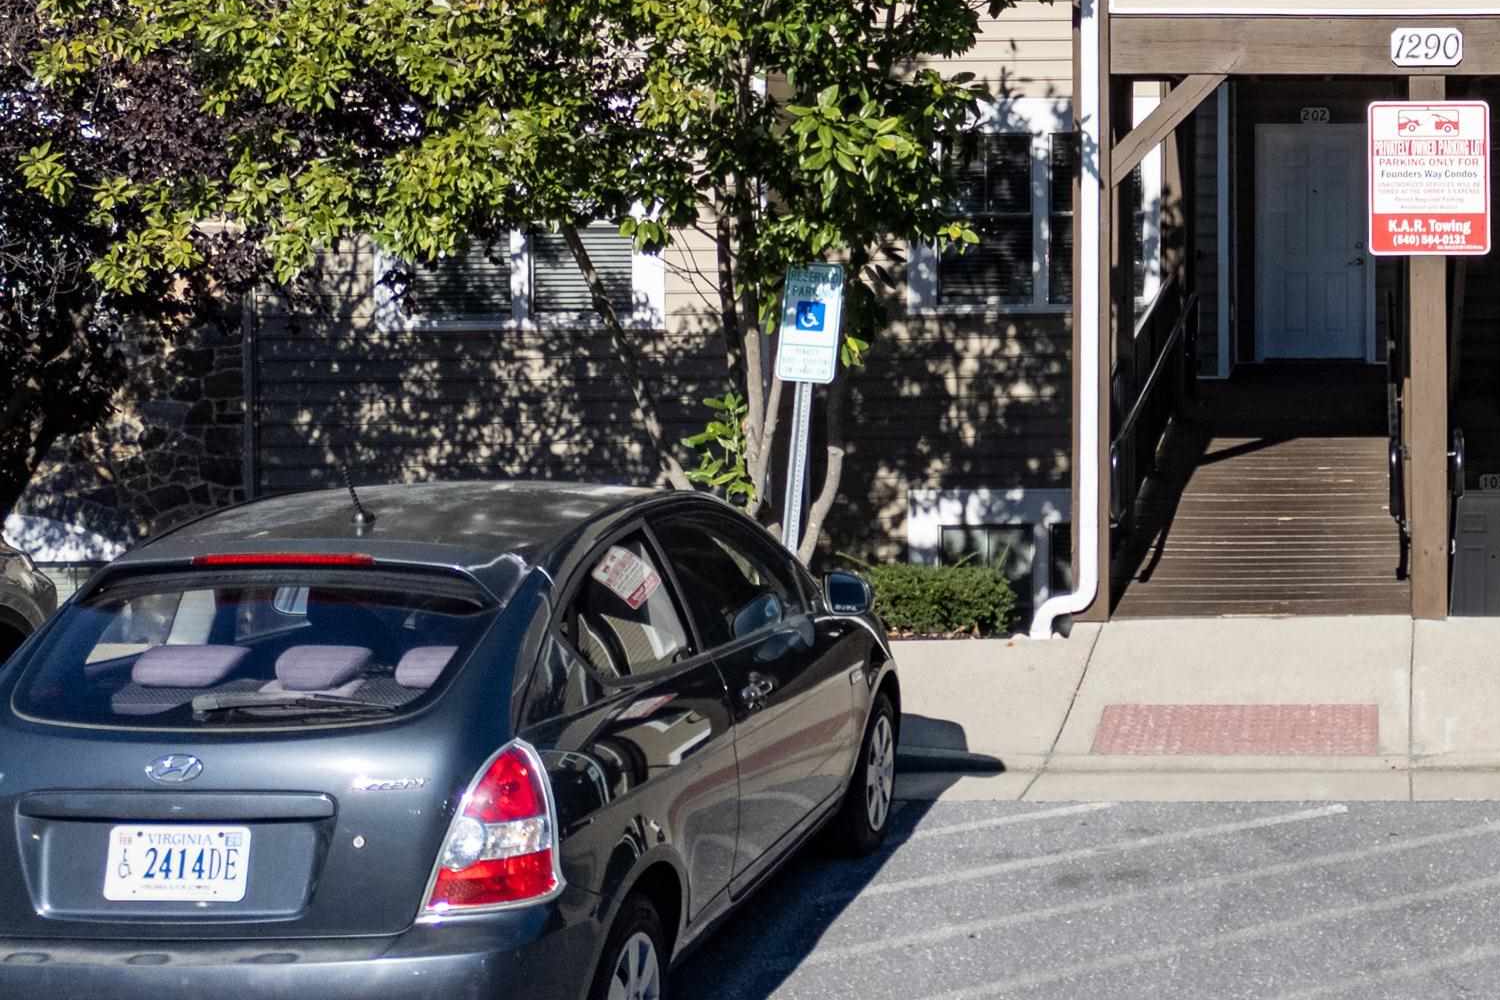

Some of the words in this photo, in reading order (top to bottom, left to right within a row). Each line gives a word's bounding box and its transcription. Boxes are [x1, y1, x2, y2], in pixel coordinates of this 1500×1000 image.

[1394, 33, 1460, 60] 1290
[1303, 110, 1327, 121] 202
[1379, 158, 1425, 166] PARKING
[1429, 158, 1455, 166] ONLY
[1458, 158, 1479, 166] FOR
[1381, 170, 1422, 178] Founders
[1425, 170, 1442, 180] Way
[1445, 170, 1478, 178] Condos
[1388, 219, 1426, 232] K.A.R.
[1428, 219, 1472, 235] Towing
[148, 833, 213, 845] VIRGINIA
[143, 847, 239, 880] 2414DE
